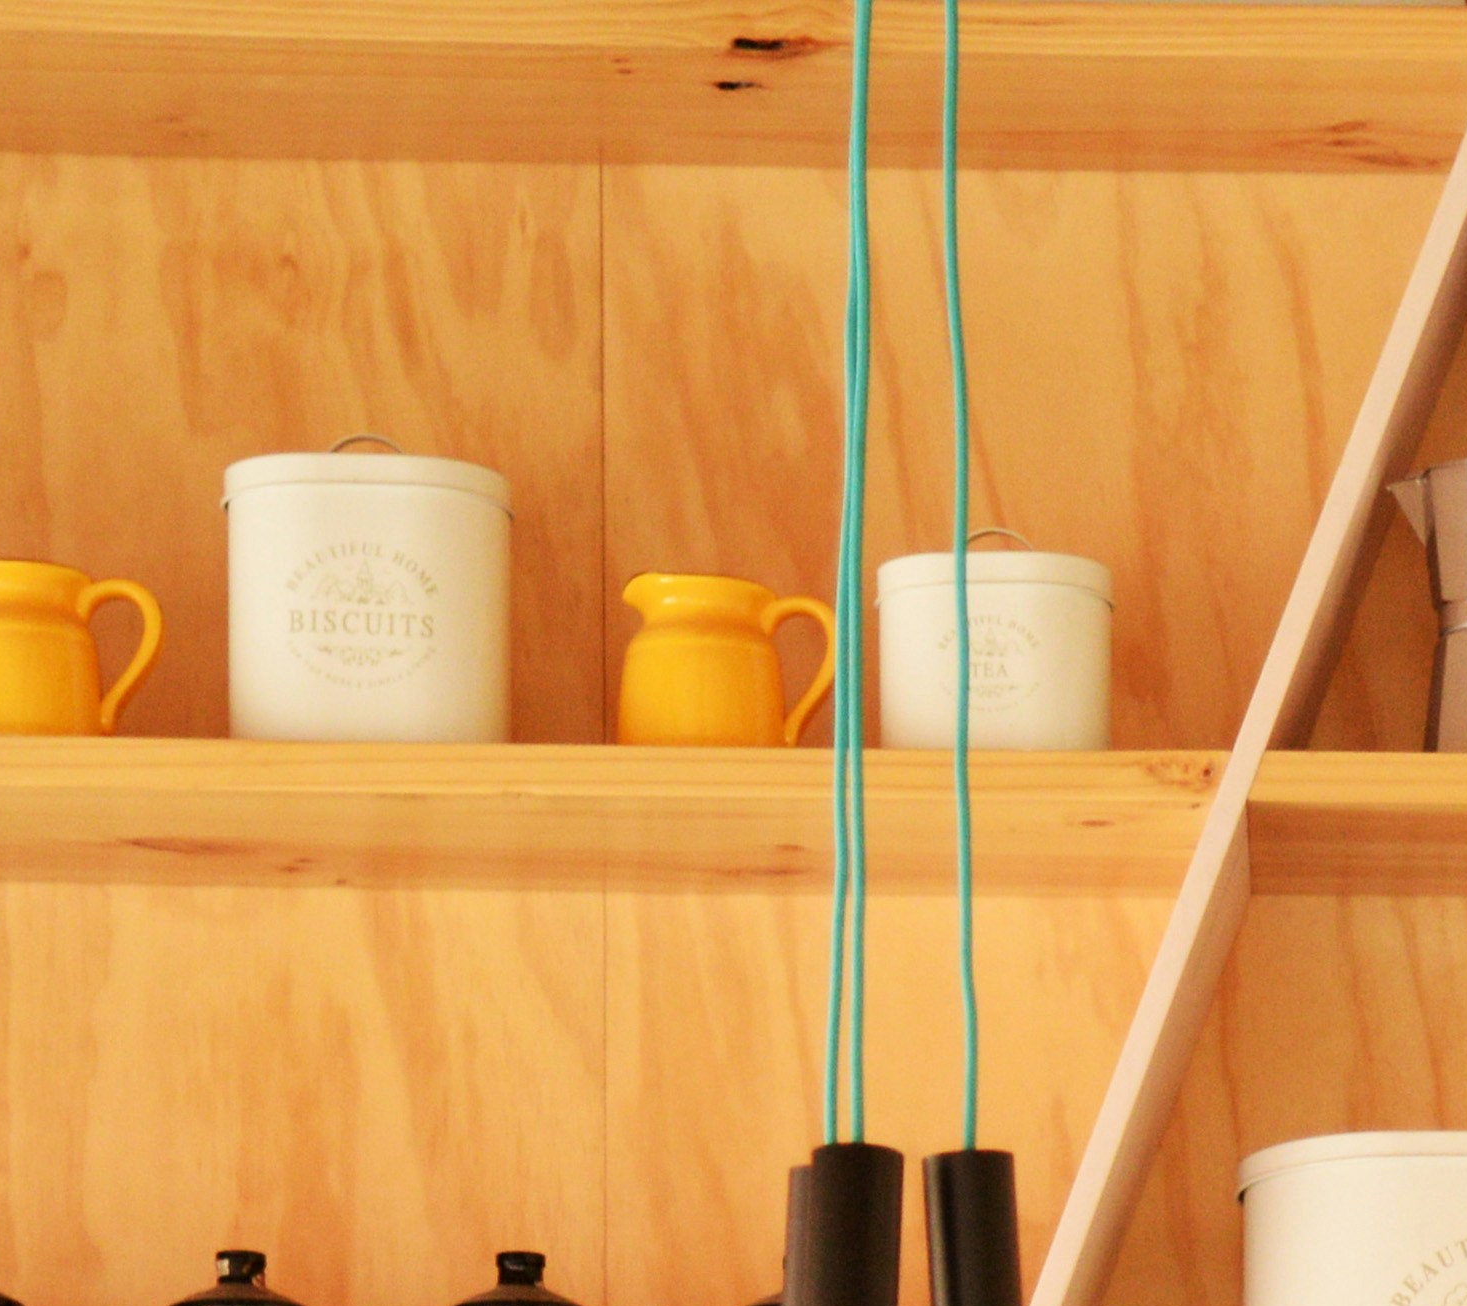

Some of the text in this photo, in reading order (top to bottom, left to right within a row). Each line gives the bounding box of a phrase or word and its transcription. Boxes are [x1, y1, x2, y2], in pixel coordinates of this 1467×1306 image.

[286, 542, 439, 596] BEAUTIFUL HOME
[288, 608, 435, 638] BISCUITS
[971, 662, 1009, 679] TEA
